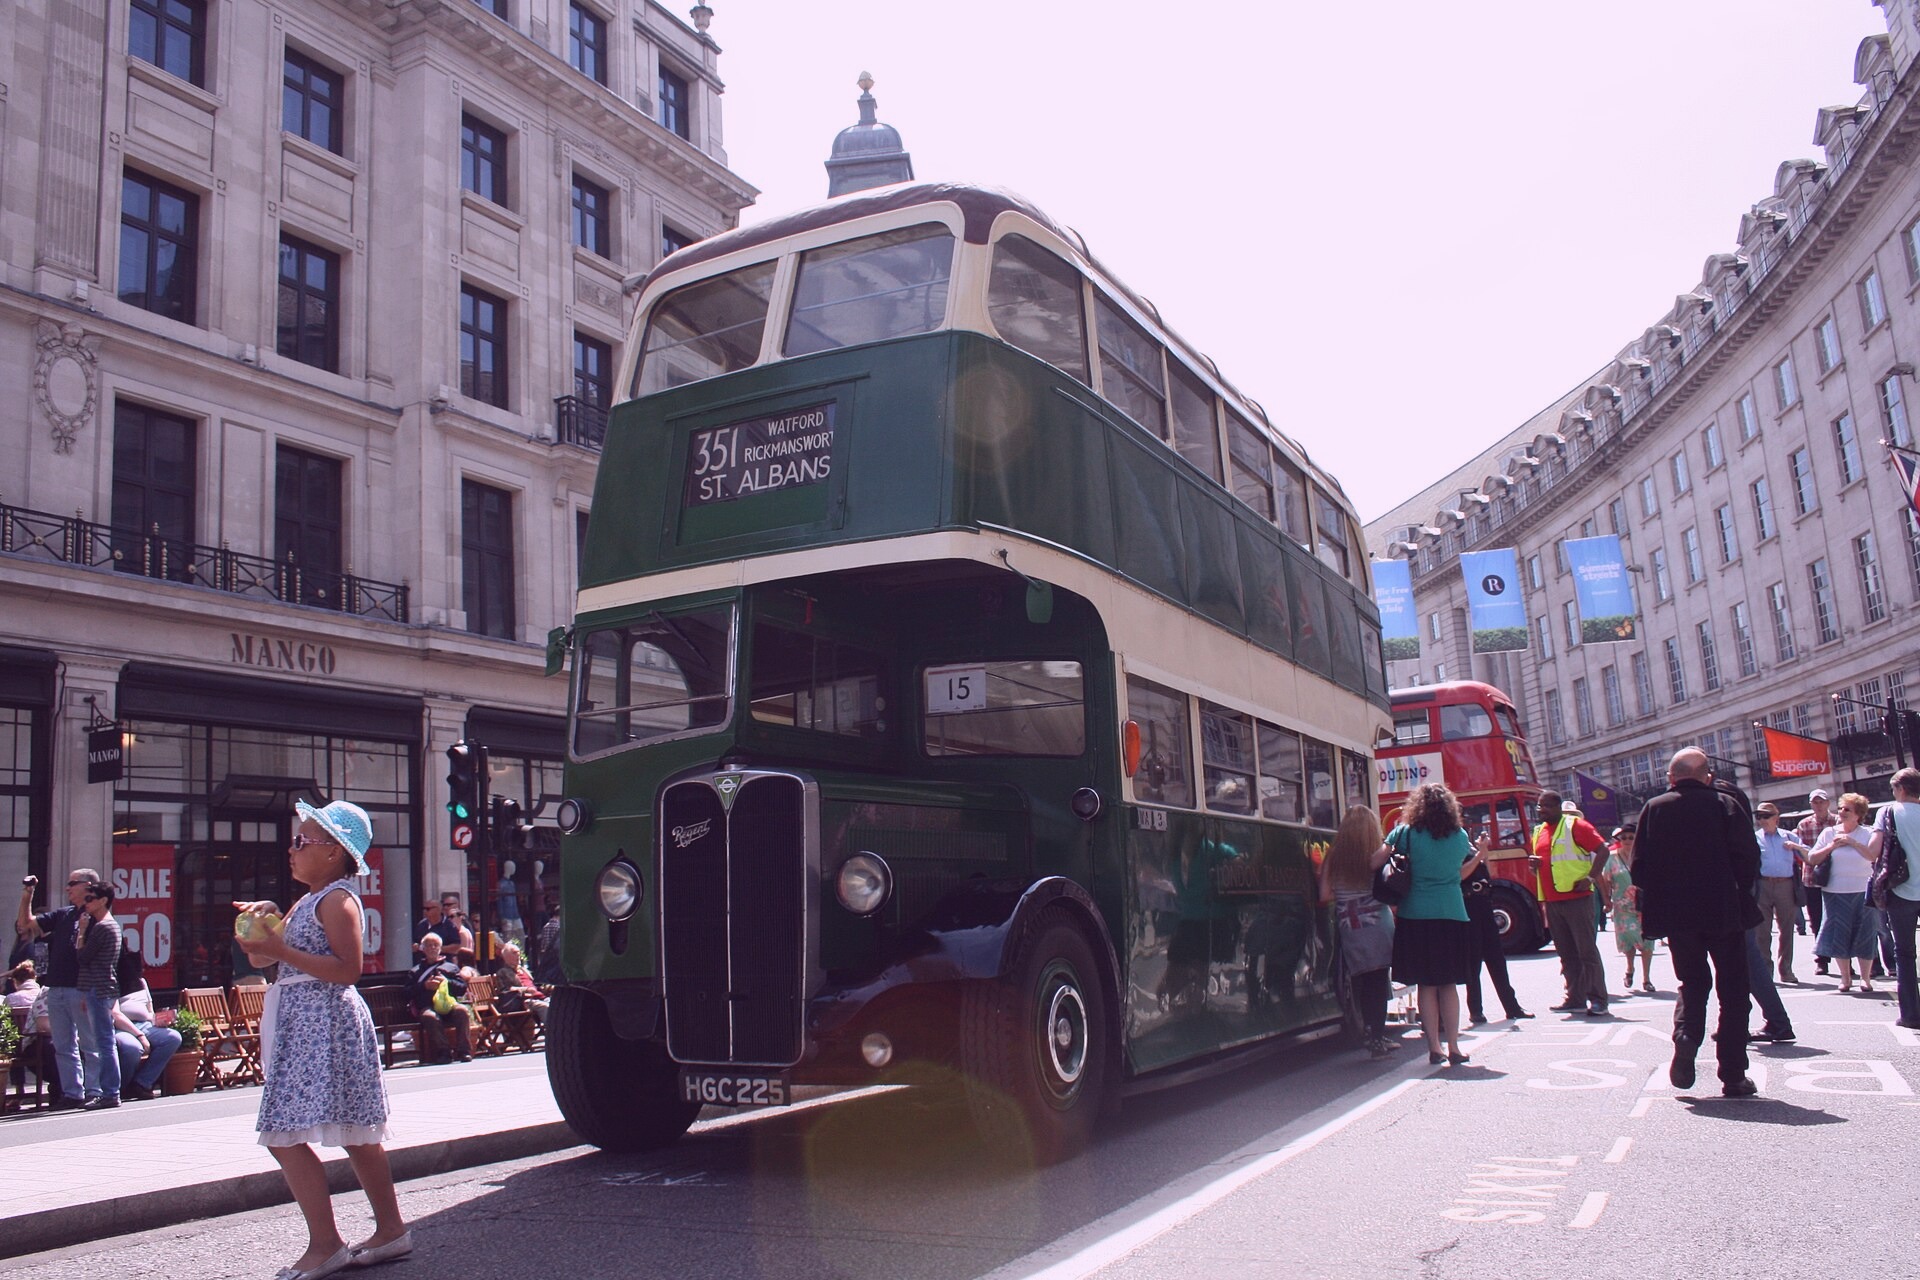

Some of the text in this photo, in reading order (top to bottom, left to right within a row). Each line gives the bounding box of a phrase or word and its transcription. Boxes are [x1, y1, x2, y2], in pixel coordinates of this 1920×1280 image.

[768, 411, 824, 437] WATFORD
[694, 427, 739, 475] 351
[744, 430, 834, 463] RICKMANSWORT
[699, 455, 831, 500] ST. ALBANS
[1578, 563, 1621, 574] Summer
[1487, 578, 1503, 592] R
[231, 633, 337, 675] MANGO
[949, 676, 970, 701] 15
[88, 749, 120, 764] MANGO
[1772, 759, 1827, 774] Superdry
[1379, 766, 1428, 782] OUTING
[672, 818, 712, 848] Regent
[113, 868, 171, 900] SALE
[350, 869, 381, 895] ALE
[1439, 1155, 1579, 1225] TAXIS
